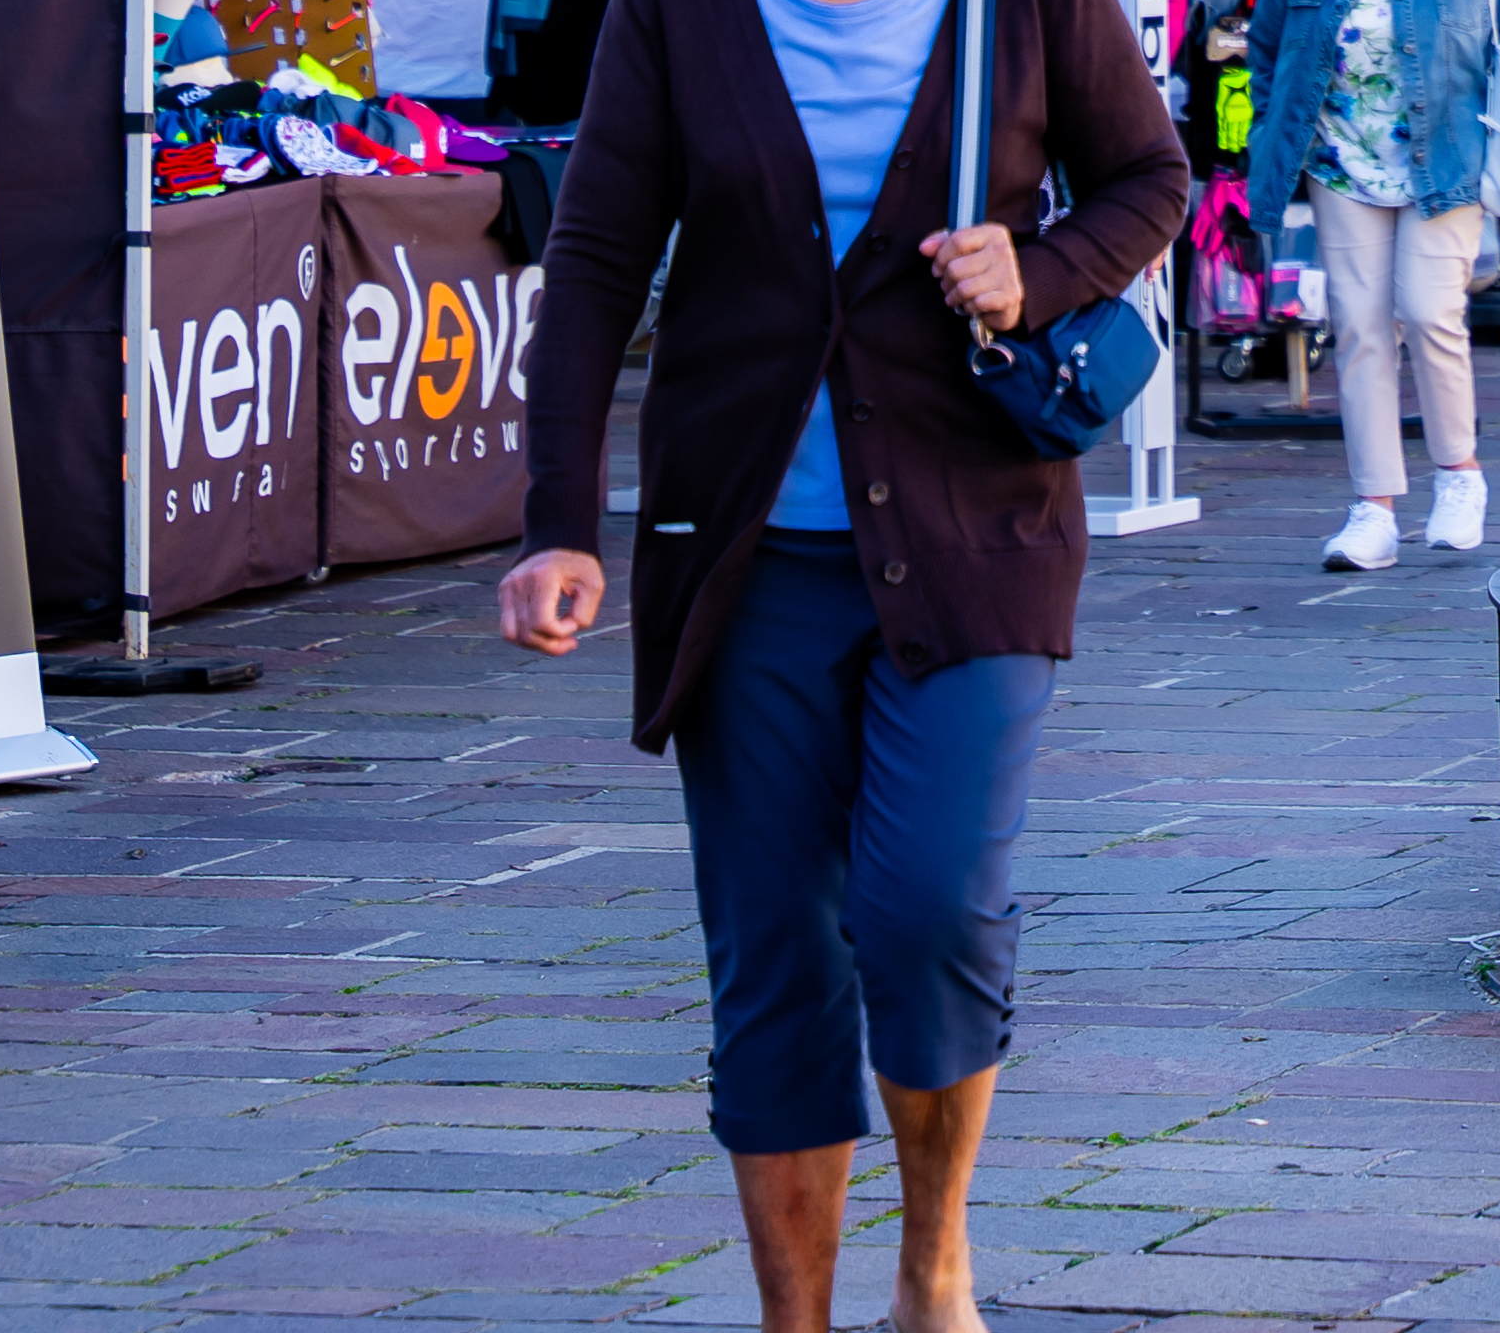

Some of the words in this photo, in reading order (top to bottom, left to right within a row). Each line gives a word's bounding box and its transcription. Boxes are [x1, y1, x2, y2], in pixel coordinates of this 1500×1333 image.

[148, 298, 302, 470] ven
[342, 245, 545, 425] eleve
[349, 421, 519, 481] sportsw
